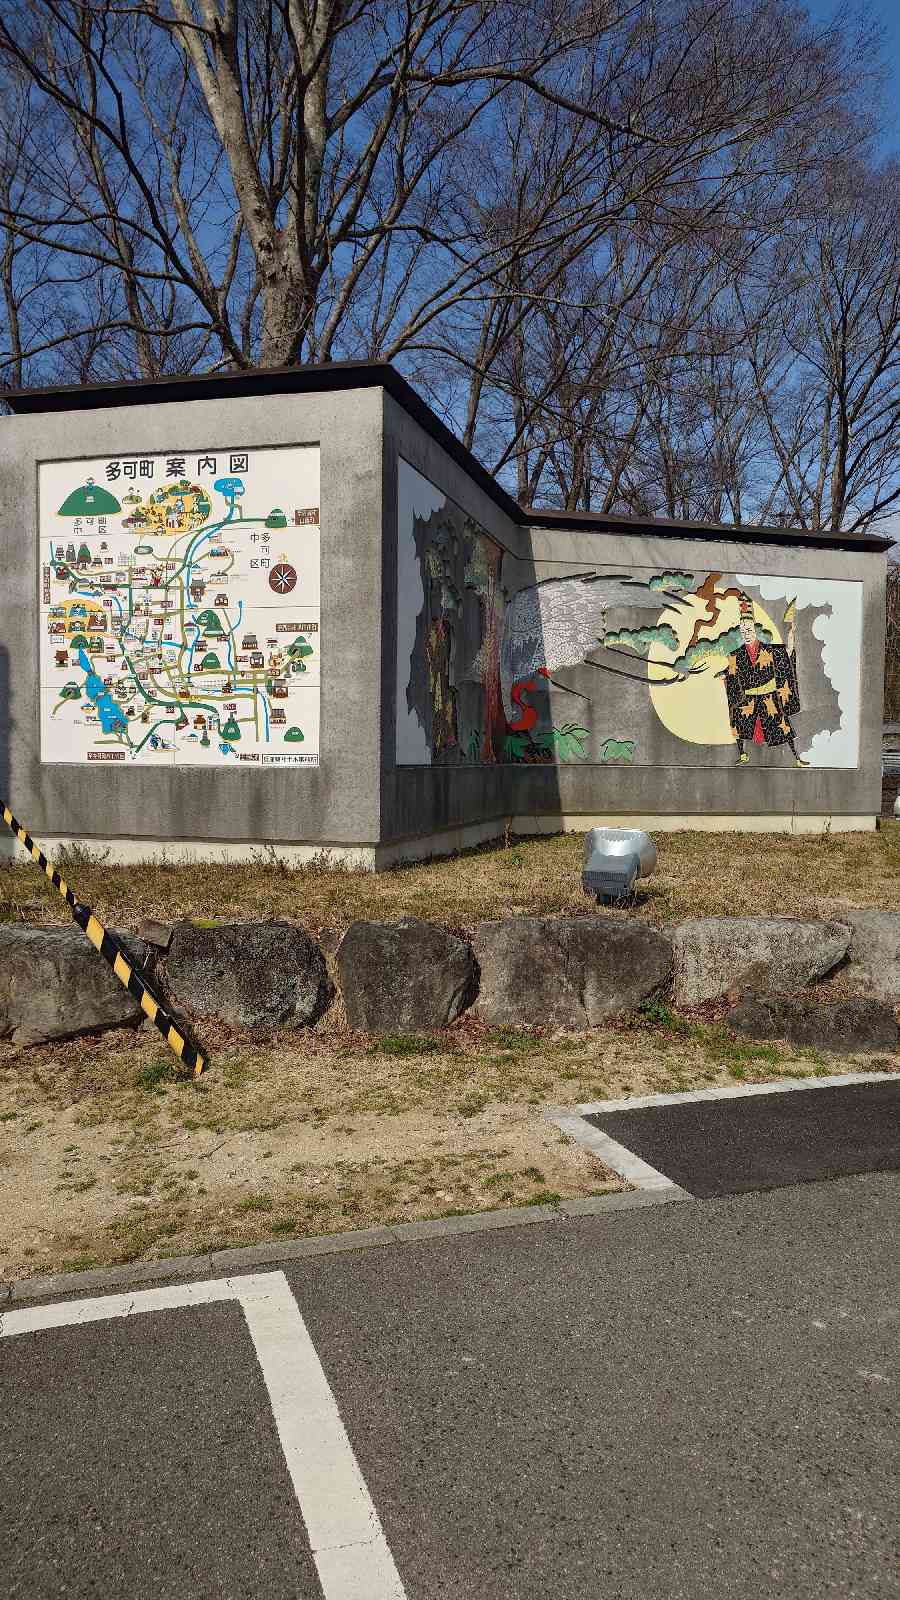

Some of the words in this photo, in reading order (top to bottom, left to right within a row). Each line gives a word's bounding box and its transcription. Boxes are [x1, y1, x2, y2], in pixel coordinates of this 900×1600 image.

[105, 453, 249, 481] 多可町案内図
